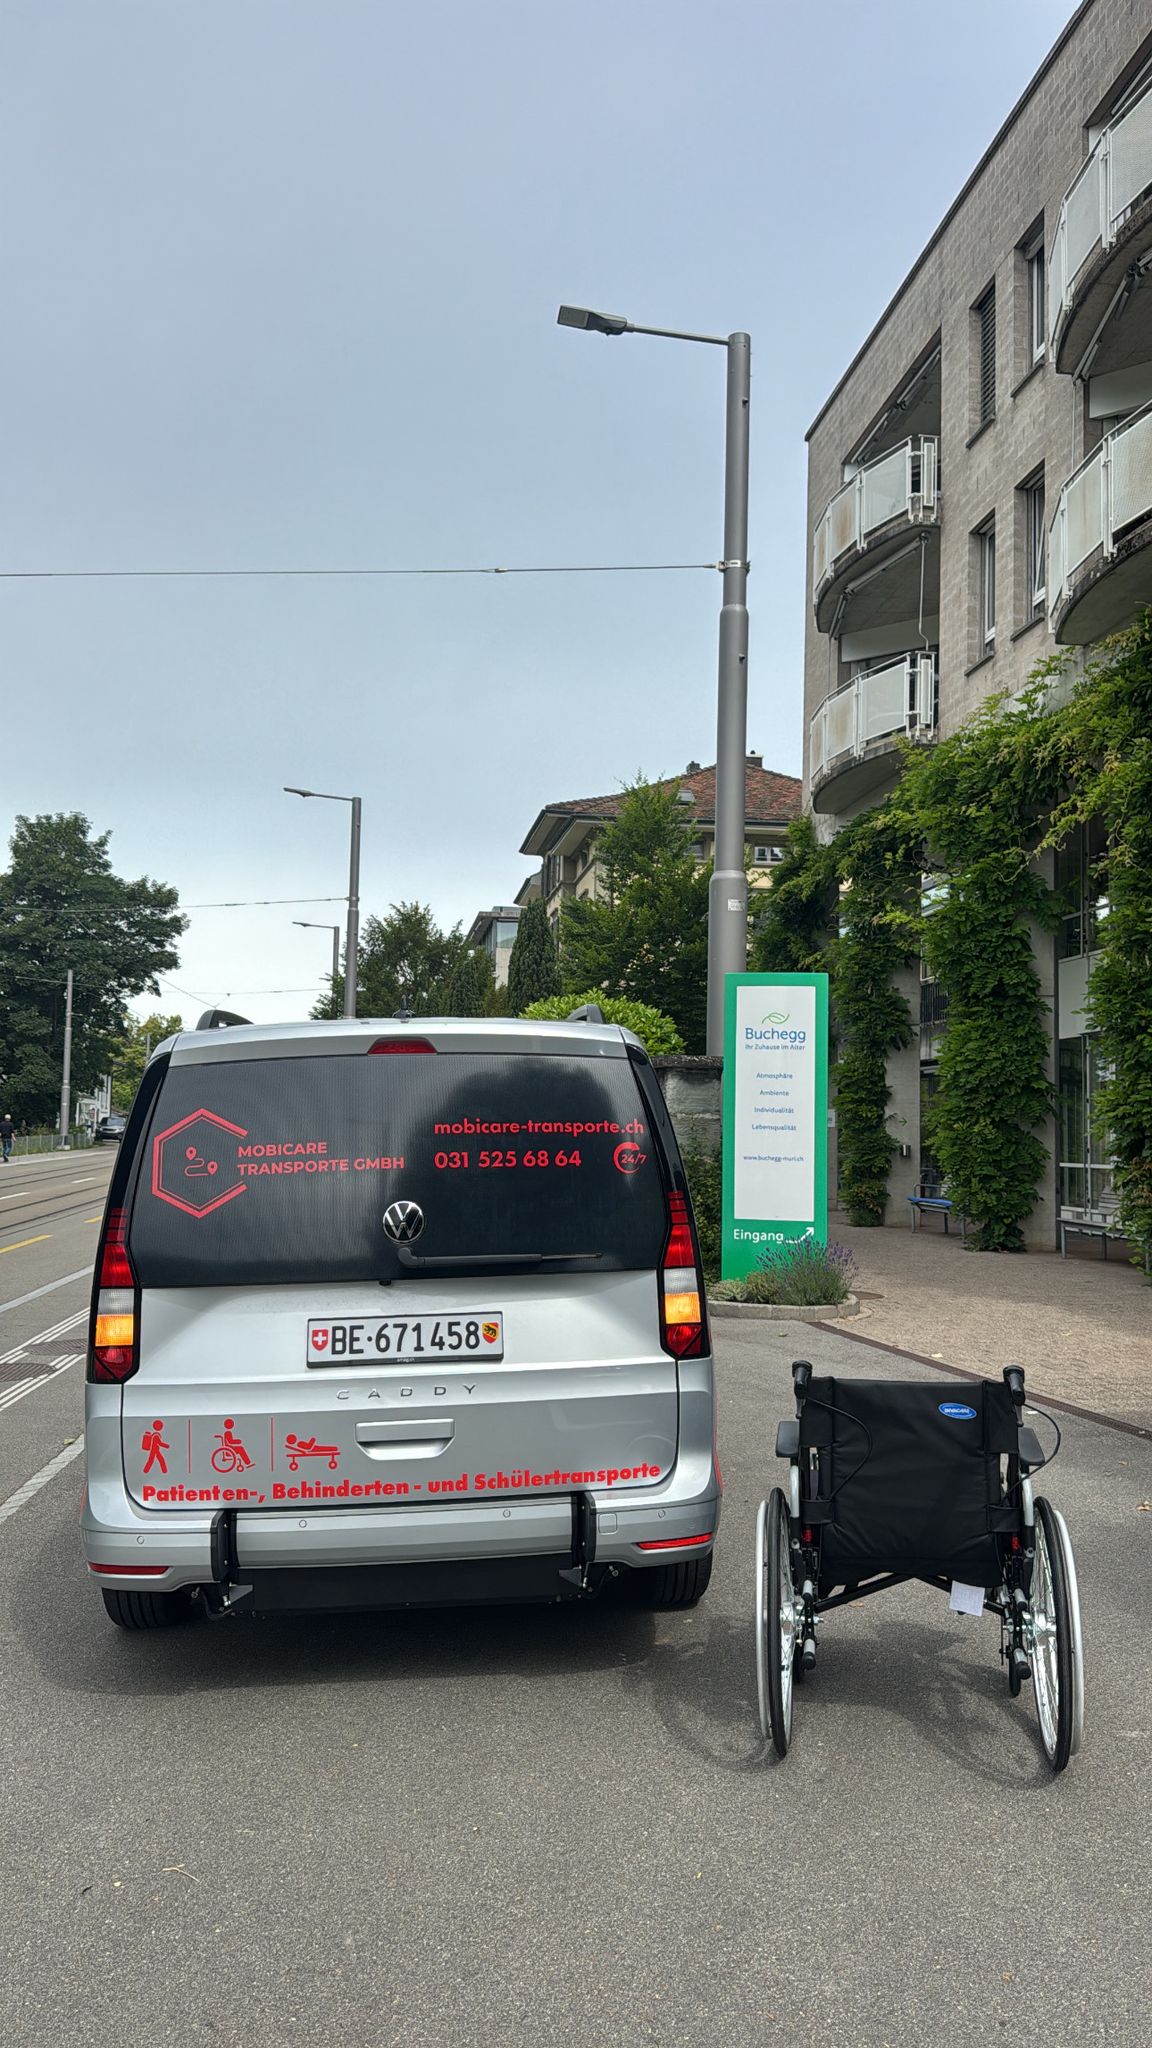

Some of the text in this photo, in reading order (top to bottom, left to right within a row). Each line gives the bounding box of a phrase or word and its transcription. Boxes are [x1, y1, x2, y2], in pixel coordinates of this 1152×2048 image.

[745, 1028, 806, 1043] Buchegg
[434, 1118, 644, 1137] mobicare-transporte.ch
[238, 1142, 327, 1157] MOBICARE
[434, 1150, 581, 1169] 031 525 68 64
[621, 1153, 647, 1164] 24/7
[237, 1157, 405, 1176] TRANSPORTE GMBH
[733, 1229, 784, 1244] Eingang
[337, 1385, 476, 1400] CADDY
[142, 1484, 265, 1503] Patienten-,
[428, 1474, 468, 1493] und
[474, 1463, 661, 1490] Schülertransporte
